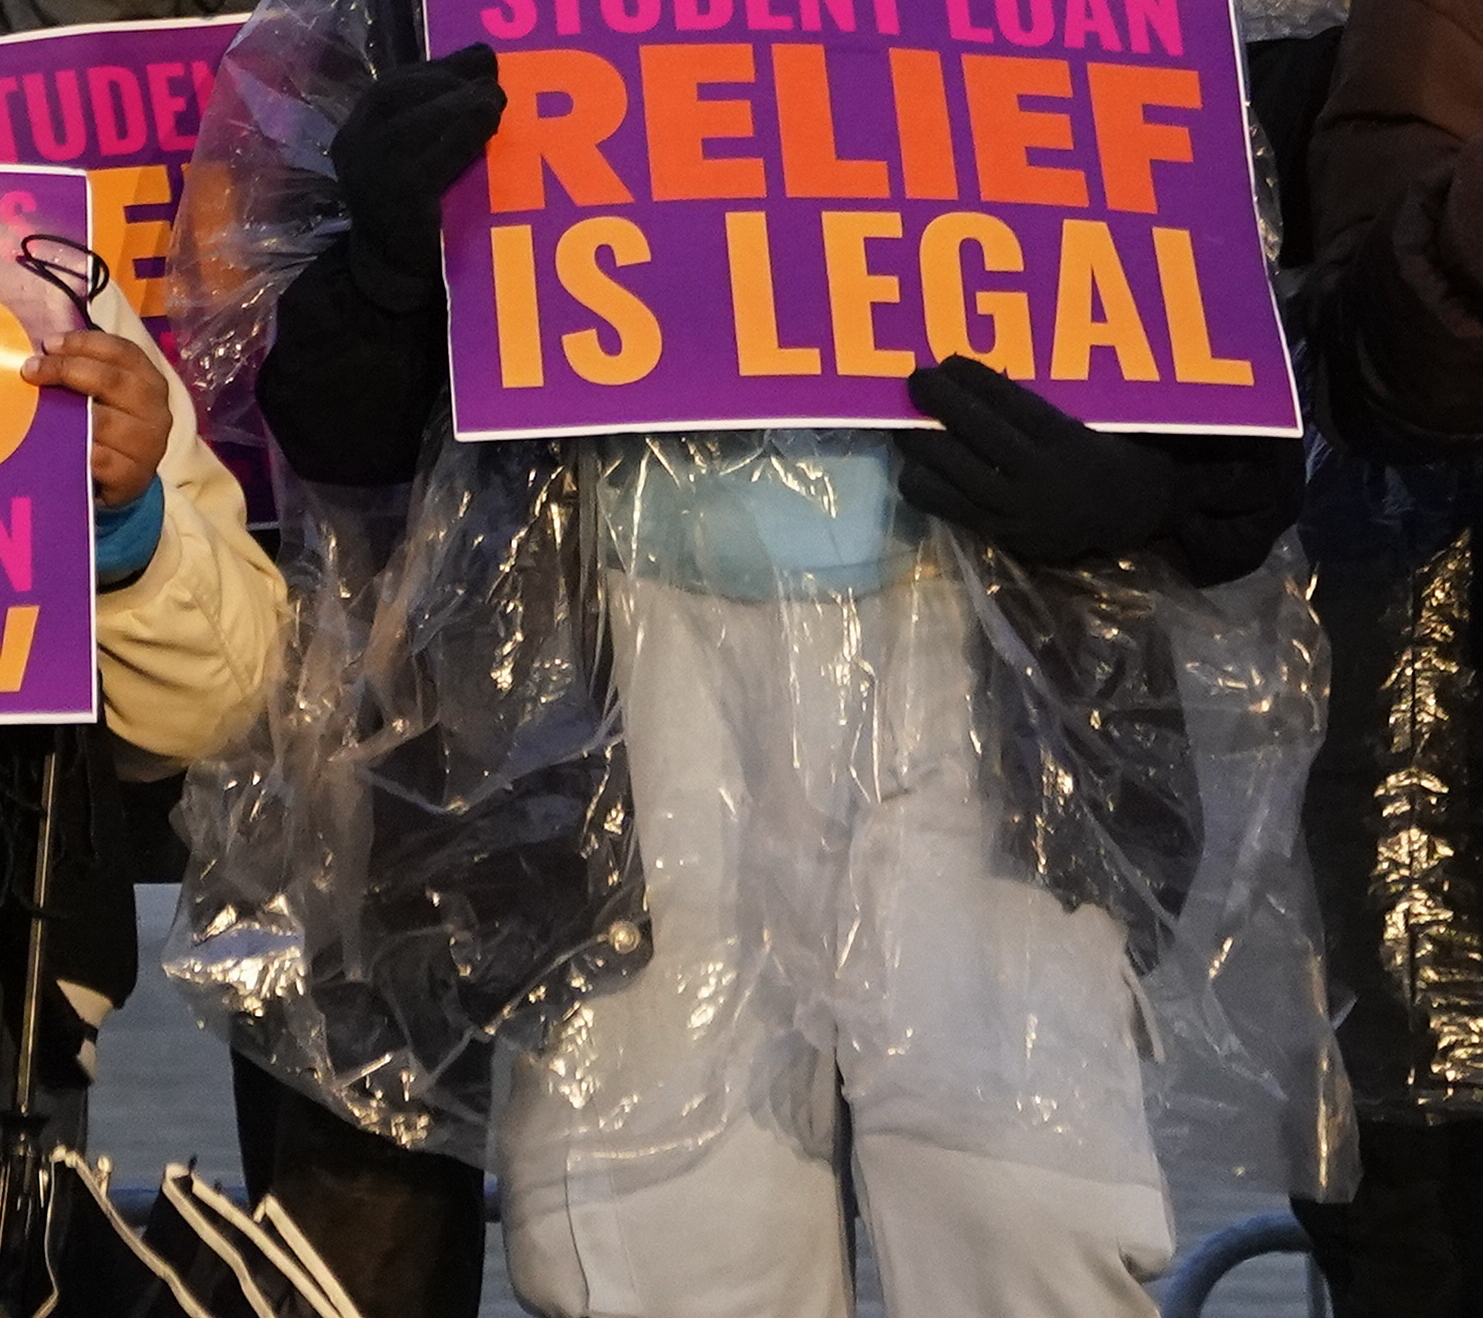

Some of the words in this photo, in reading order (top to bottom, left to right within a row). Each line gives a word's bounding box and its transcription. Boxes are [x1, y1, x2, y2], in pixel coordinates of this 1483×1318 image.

[487, 43, 1202, 216] RELIEF
[491, 215, 663, 388] IS
[725, 210, 1254, 386] LEGAL
